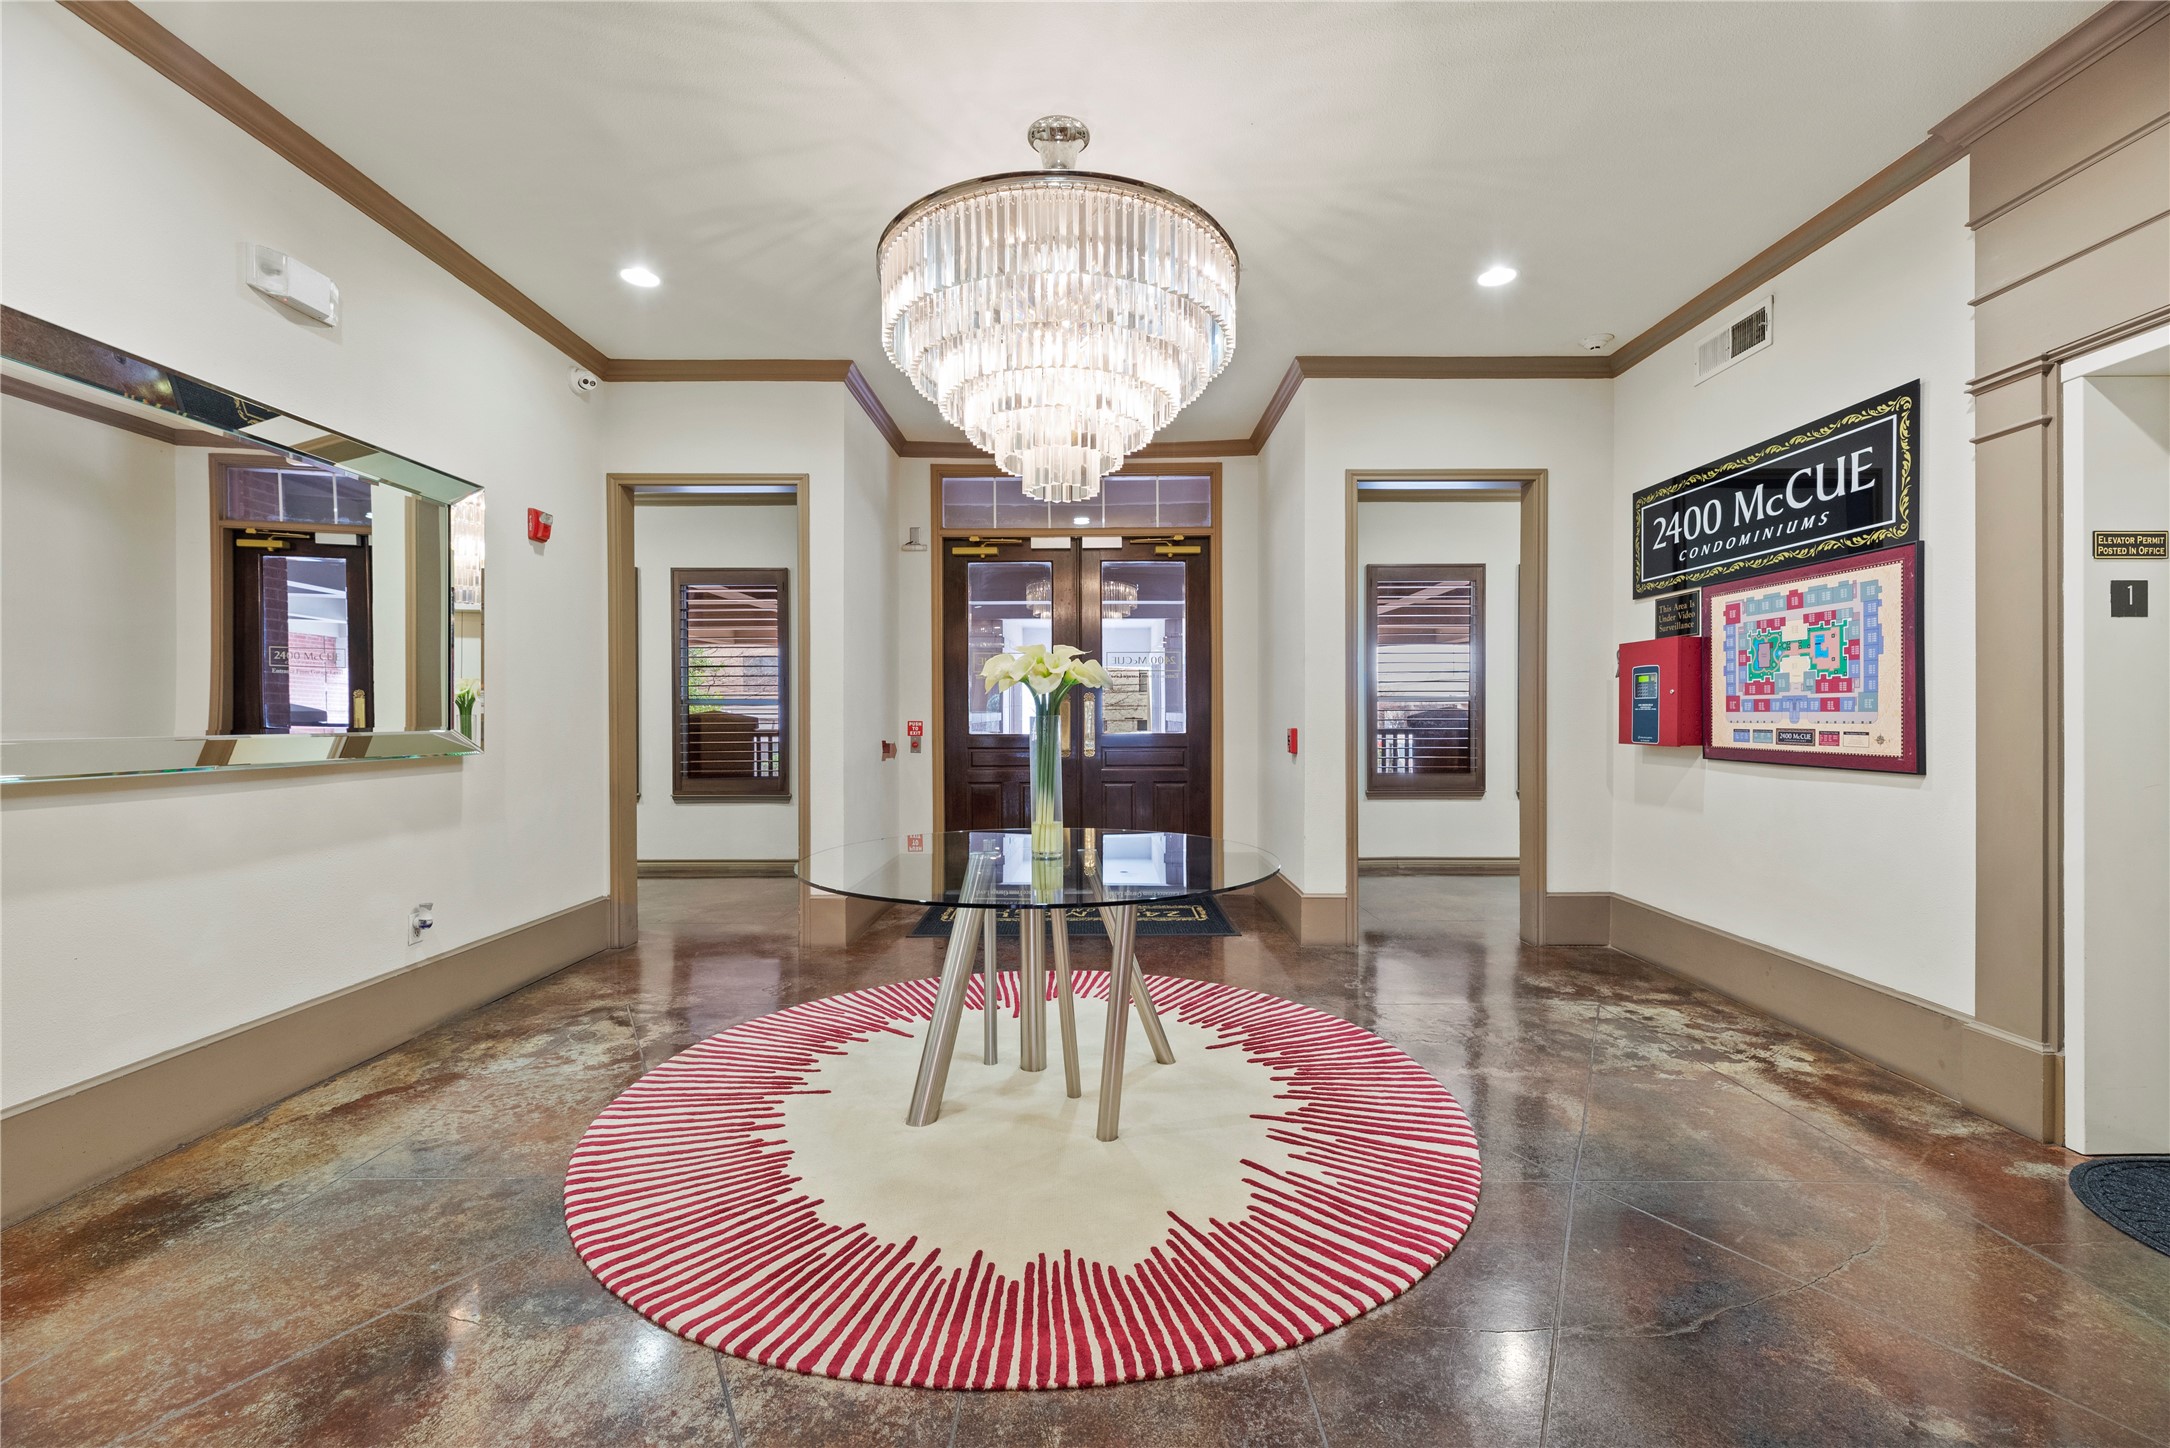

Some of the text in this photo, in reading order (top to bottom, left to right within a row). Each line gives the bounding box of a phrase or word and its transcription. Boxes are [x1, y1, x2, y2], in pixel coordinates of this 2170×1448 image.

[1652, 446, 1876, 550] 2400 McCUE
[1678, 511, 1830, 562] CONDOMINIUMS
[2098, 536, 2165, 544] ELEVATOR PERMIT
[2138, 546, 2165, 554] OFFICE
[2127, 585, 2133, 605] 1
[1659, 600, 1695, 613] This Area Is
[1658, 610, 1696, 623] Under Video
[1659, 621, 1695, 632] Surveillance
[274, 650, 300, 660] 2400
